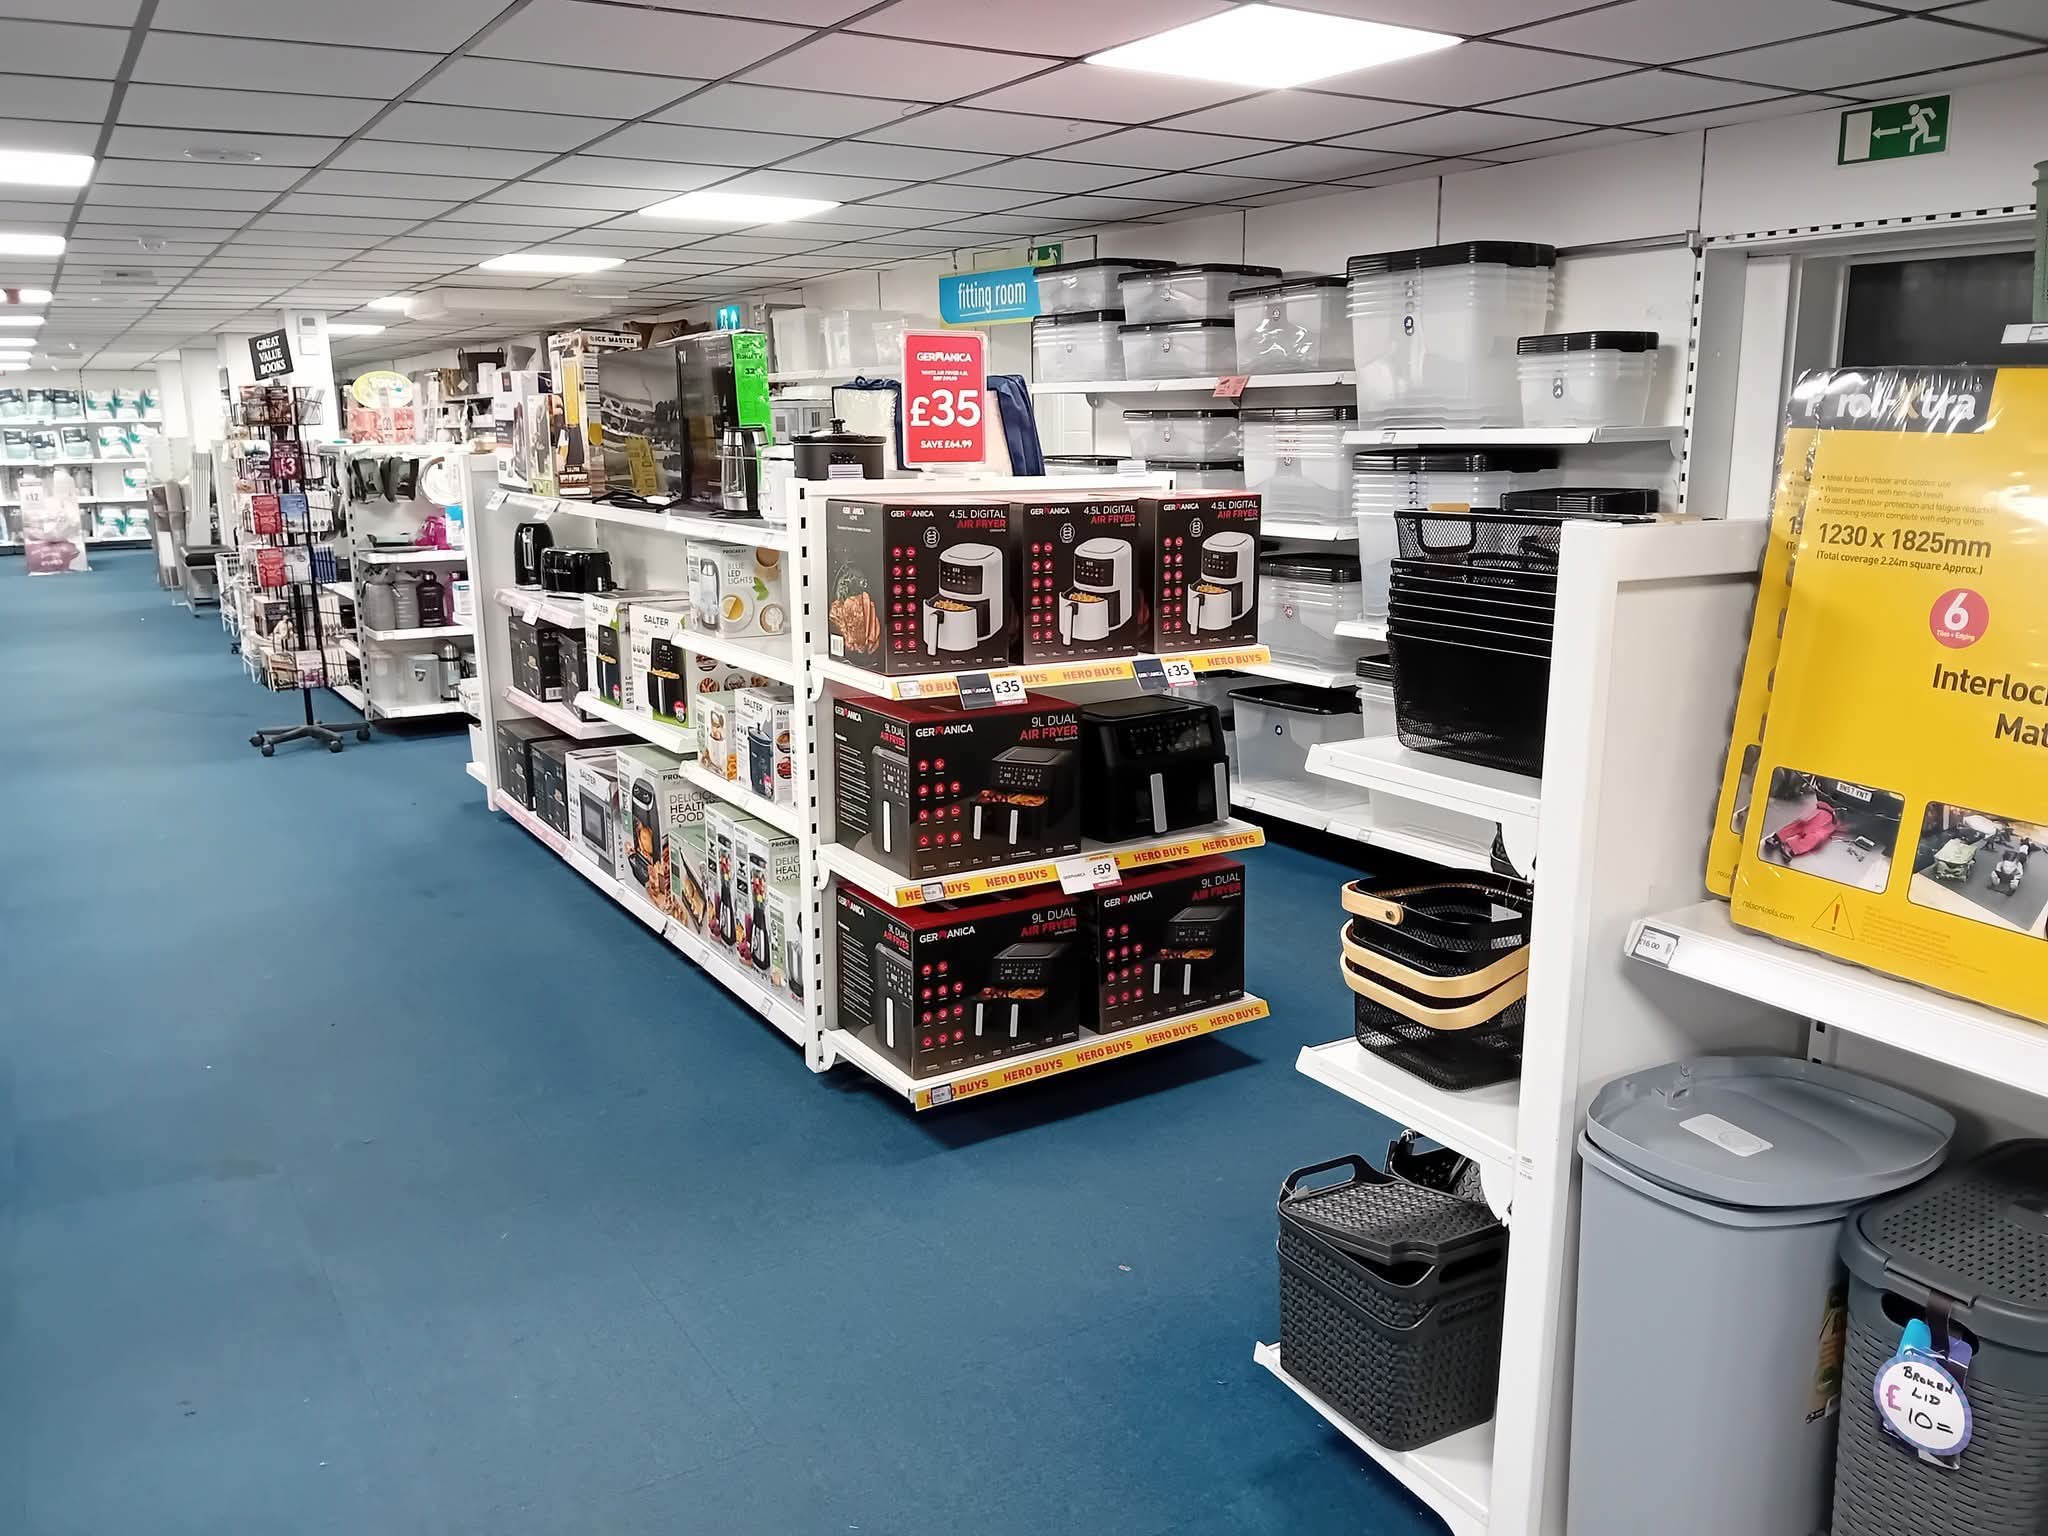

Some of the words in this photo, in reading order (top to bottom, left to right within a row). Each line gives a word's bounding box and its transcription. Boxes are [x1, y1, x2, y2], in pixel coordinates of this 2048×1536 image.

[958, 281, 992, 313] fitting
[996, 282, 1026, 306] room
[256, 336, 280, 350] GREAT
[258, 348, 282, 362] VALUE
[260, 359, 286, 374] BOOKS
[910, 389, 981, 428] £35
[920, 440, 944, 448] SAVE
[944, 440, 972, 448] £64.99
[1084, 506, 1100, 515] 4.5L
[1103, 504, 1136, 514] DIGITAL
[1210, 501, 1226, 510] 4.5L
[1228, 500, 1258, 509] DIGITAL
[949, 510, 968, 518] 4.5L
[970, 509, 1006, 518] DIGITAL
[1091, 516, 1110, 524] AIR
[1112, 514, 1136, 524] FRYER
[1217, 510, 1234, 519] AIR
[1236, 510, 1258, 518] FRYER
[1886, 512, 1918, 521] complete
[957, 520, 974, 528] AIR
[976, 520, 1006, 528] FRYER
[1819, 522, 1868, 546] 1230
[1870, 532, 1886, 548] x
[1892, 528, 1992, 558] 1825mm
[1841, 554, 1879, 566] coverage
[1880, 556, 1908, 568] 2.24m
[1909, 559, 1941, 572] square
[728, 570, 741, 578] LED
[728, 576, 753, 584] LIGHTS
[1944, 592, 1968, 631] 6
[644, 614, 670, 626] SALTER
[1208, 656, 1235, 666] HERO
[1237, 654, 1263, 664] BUYS
[1063, 669, 1092, 680] HERO
[1094, 666, 1123, 678] BUYS
[1168, 664, 1190, 676] £35
[996, 680, 1020, 694] £35
[1932, 663, 2048, 706] Interloc
[743, 697, 763, 712] SALTER
[1032, 716, 1044, 728] 9L
[1048, 714, 1078, 726] DUAL
[1020, 728, 1040, 740] AIR
[1042, 724, 1078, 738] FRYER
[671, 812, 704, 824] FOOD
[1202, 840, 1230, 851] HERO
[1230, 835, 1256, 846] BUYS
[1134, 851, 1163, 862] HERO
[1163, 846, 1190, 858] BUYS
[1093, 864, 1111, 876] £59
[986, 875, 1017, 888] HERO
[1018, 869, 1048, 882] BUYS
[1202, 878, 1212, 888] 9L
[1215, 872, 1241, 886] DUAL
[904, 888, 922, 902] HE
[1192, 890, 1208, 900] AIR
[1032, 912, 1044, 924] 9L
[1048, 907, 1077, 920] DUAL
[1021, 924, 1040, 938] AIR
[1042, 918, 1077, 932] FRYER
[1210, 1014, 1236, 1027] HERO
[1236, 1006, 1262, 1020] BUYS
[1145, 1030, 1172, 1044] HERO
[1172, 1023, 1199, 1037] BUYS
[1076, 1048, 1105, 1063] HERO
[1106, 1040, 1134, 1054] BUYS
[1003, 1066, 1033, 1082] HERO
[1036, 1058, 1064, 1074] BUYS
[959, 1079, 990, 1094] BUYS
[1903, 1366, 1954, 1395] BROKEN
[1886, 1384, 1902, 1412] £
[1912, 1387, 1941, 1406] LID
